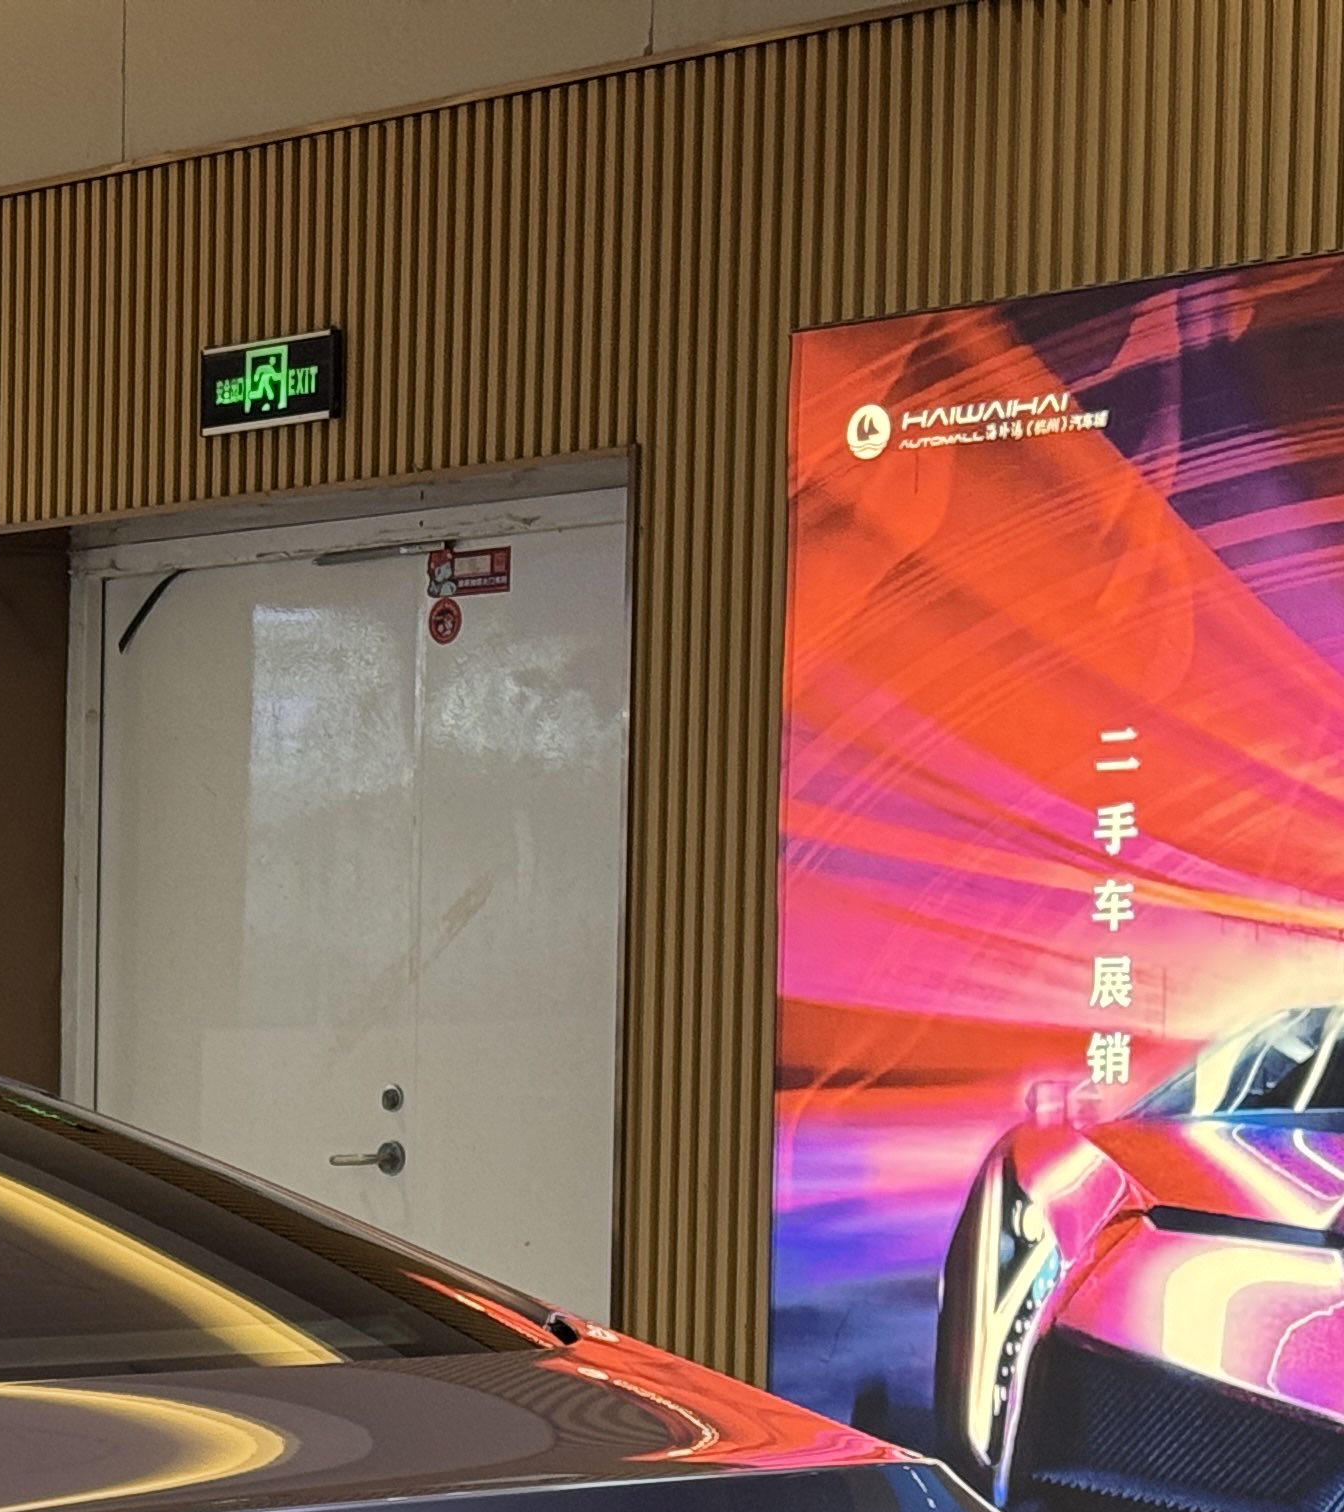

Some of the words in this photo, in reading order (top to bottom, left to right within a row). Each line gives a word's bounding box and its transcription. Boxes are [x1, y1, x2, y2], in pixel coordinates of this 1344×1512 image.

[288, 365, 318, 396] EXIT
[901, 392, 1072, 430] HAIWAIHAI
[1086, 729, 1141, 1085] 二手车展销
